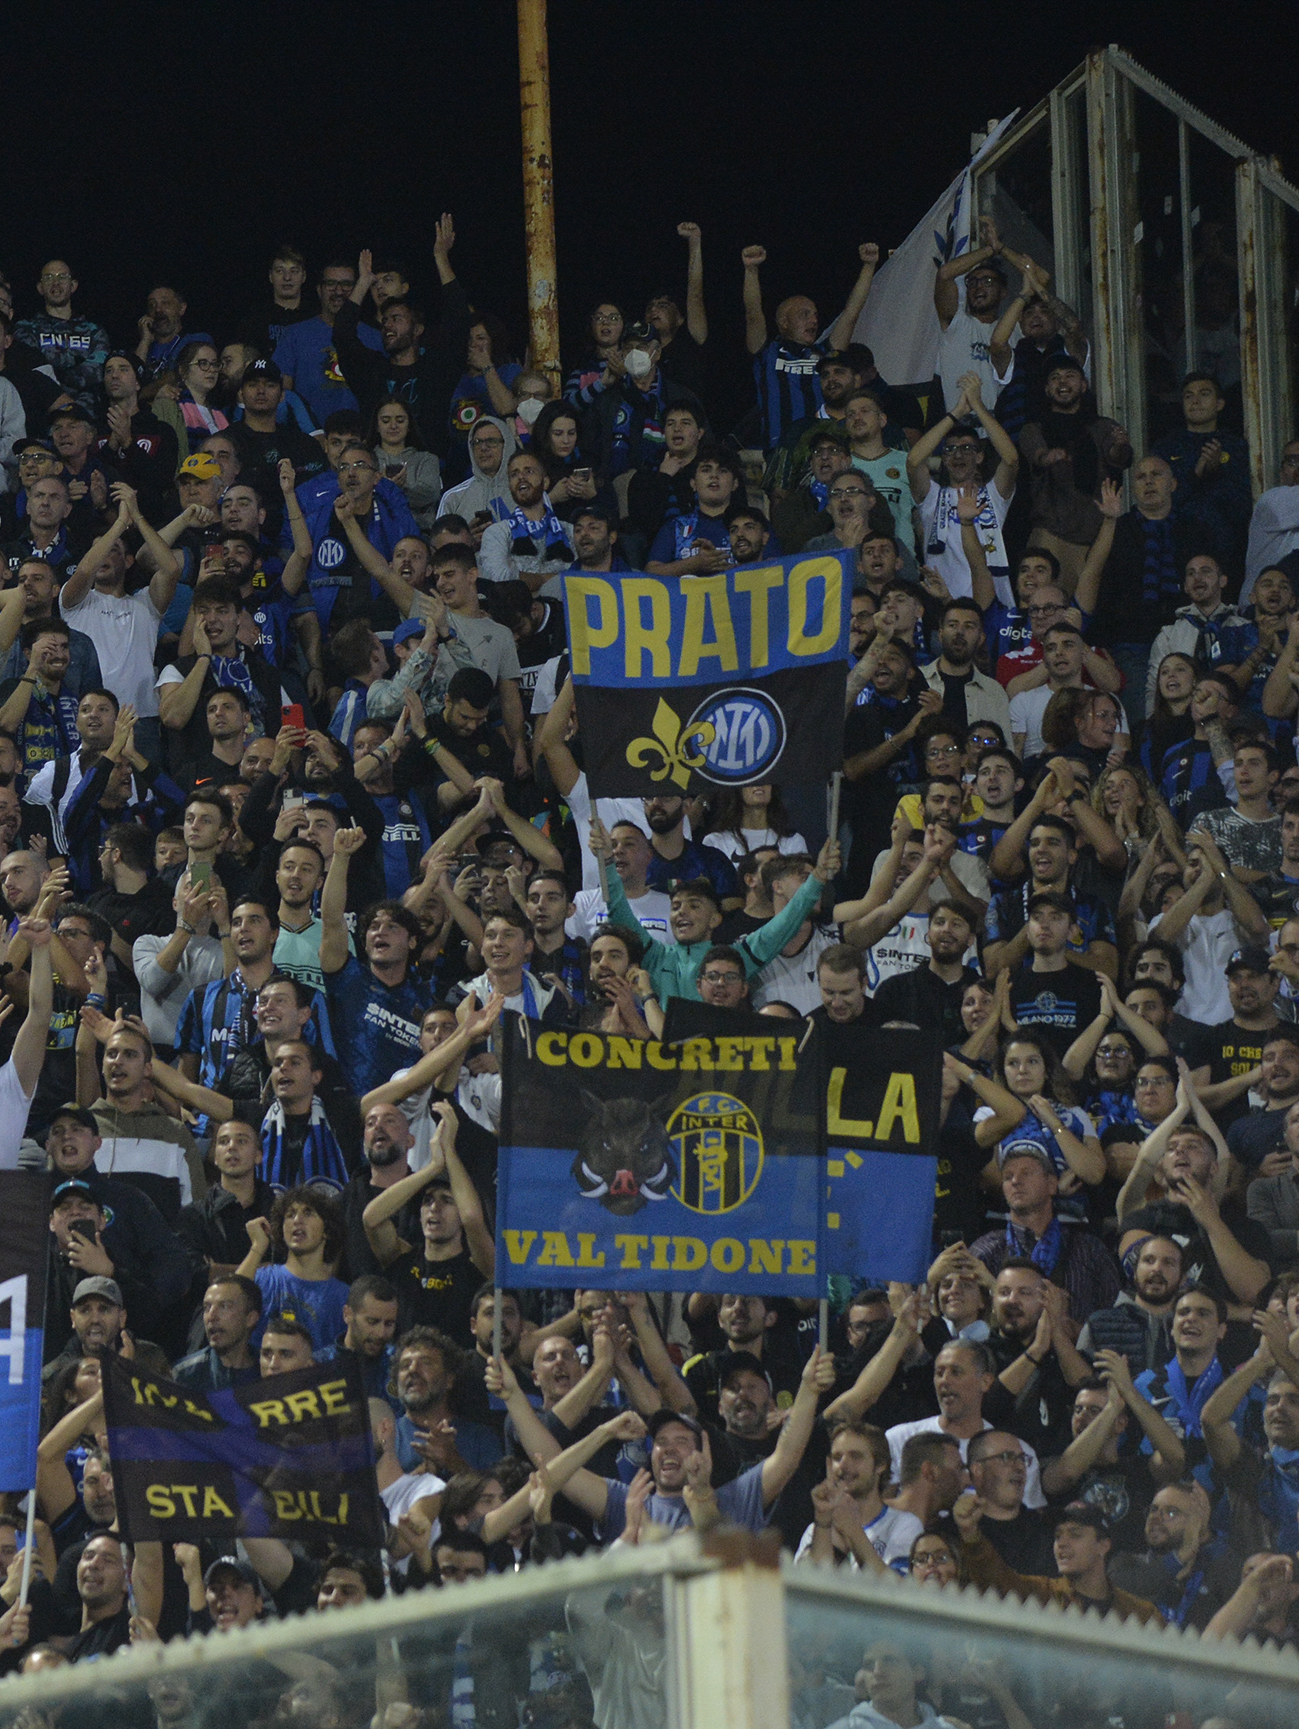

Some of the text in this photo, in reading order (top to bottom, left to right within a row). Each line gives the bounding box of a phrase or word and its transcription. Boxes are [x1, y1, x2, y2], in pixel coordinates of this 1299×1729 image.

[564, 556, 843, 678] PRATO
[363, 1013, 387, 1029] FAN
[535, 1031, 797, 1071] CONCRETI
[691, 1113, 749, 1131] INTER
